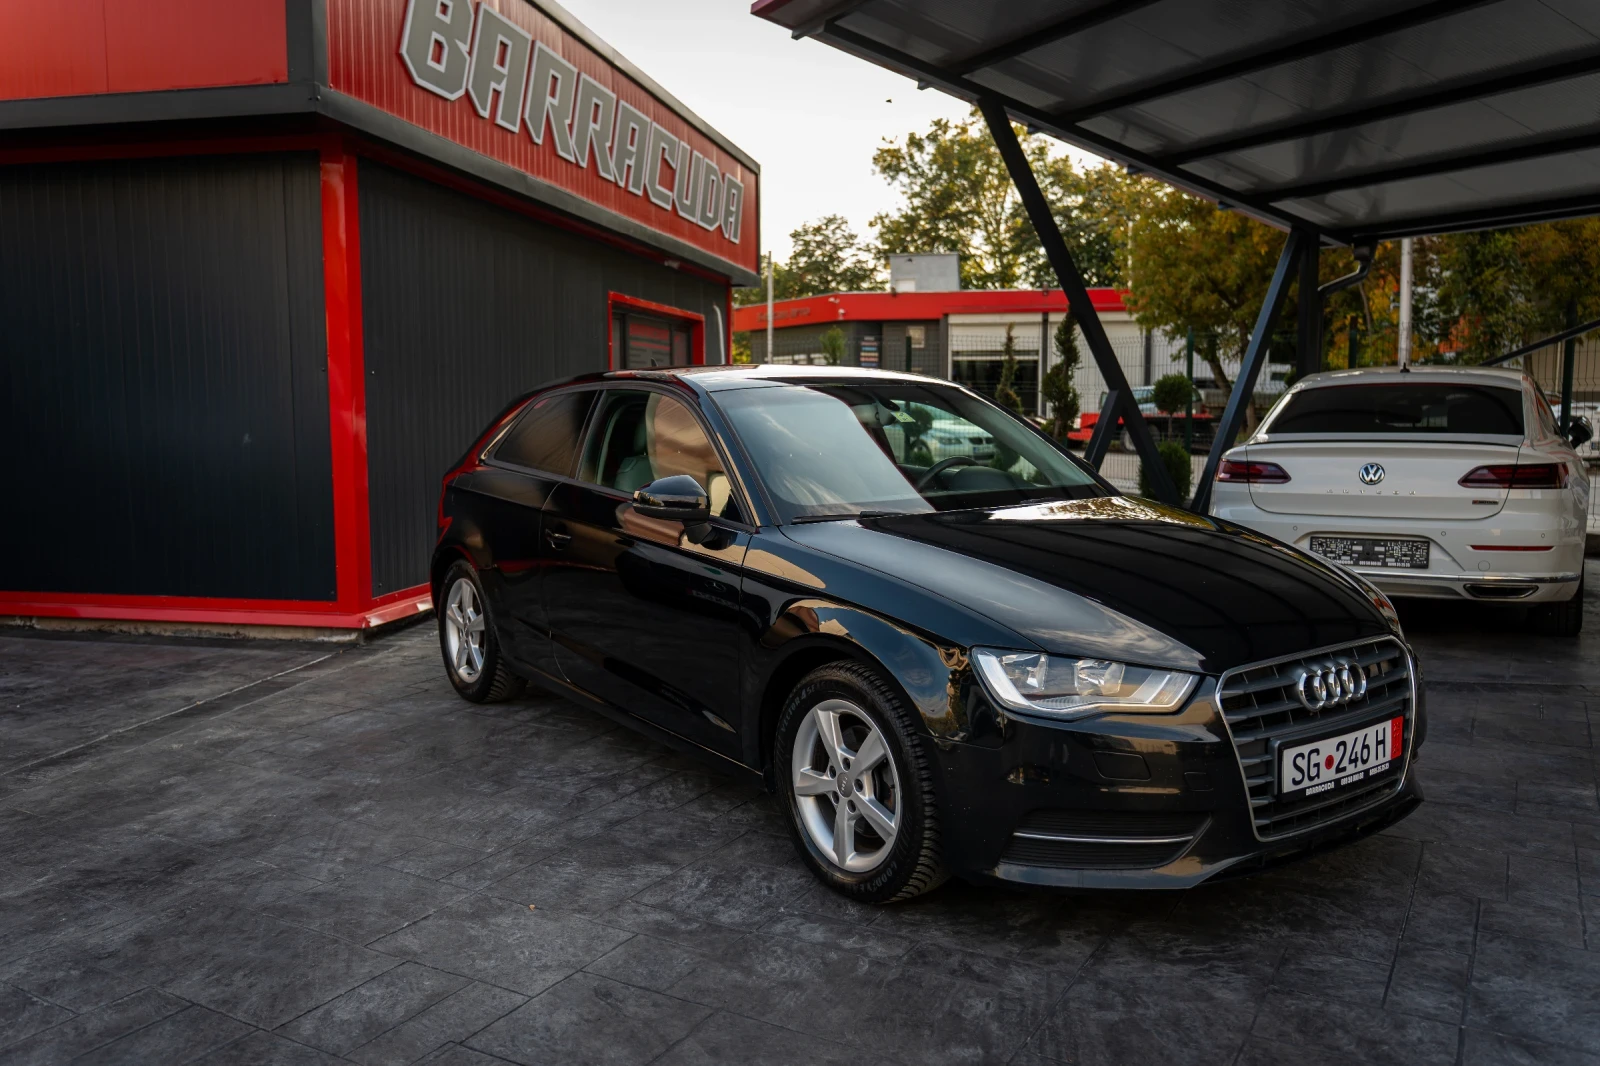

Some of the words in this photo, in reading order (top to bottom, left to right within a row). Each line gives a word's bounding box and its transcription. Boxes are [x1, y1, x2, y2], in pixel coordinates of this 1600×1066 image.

[398, 0, 744, 244] BARRACUDA
[1291, 747, 1320, 786] SG
[1334, 733, 1371, 775] 246
[1375, 726, 1387, 761] H
